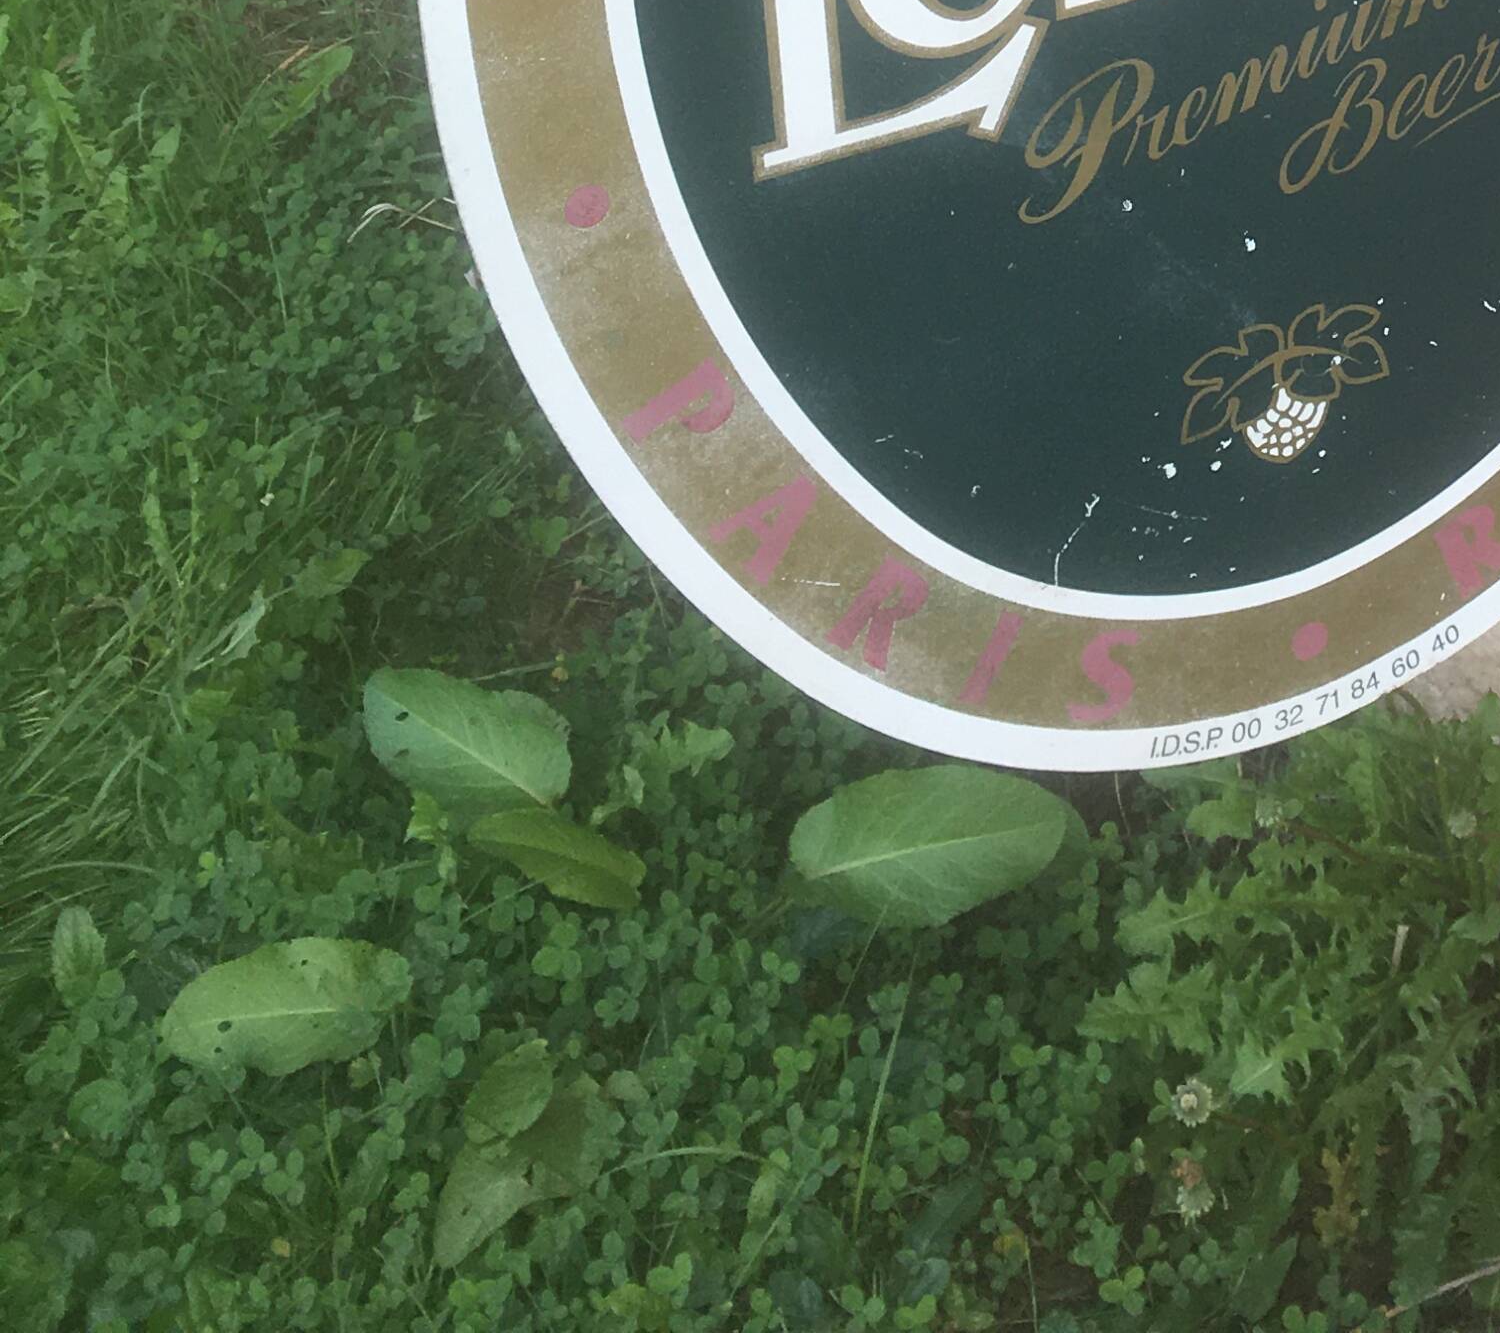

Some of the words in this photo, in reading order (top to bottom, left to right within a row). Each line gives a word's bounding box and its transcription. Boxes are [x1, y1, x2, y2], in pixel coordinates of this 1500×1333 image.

[620, 358, 1139, 722] PARIS
[1231, 717, 1262, 743] 00
[1274, 703, 1304, 731] 32
[1315, 690, 1340, 716] 71
[1351, 671, 1380, 699] 84
[1391, 648, 1421, 678] 60
[1431, 624, 1459, 653] 40
